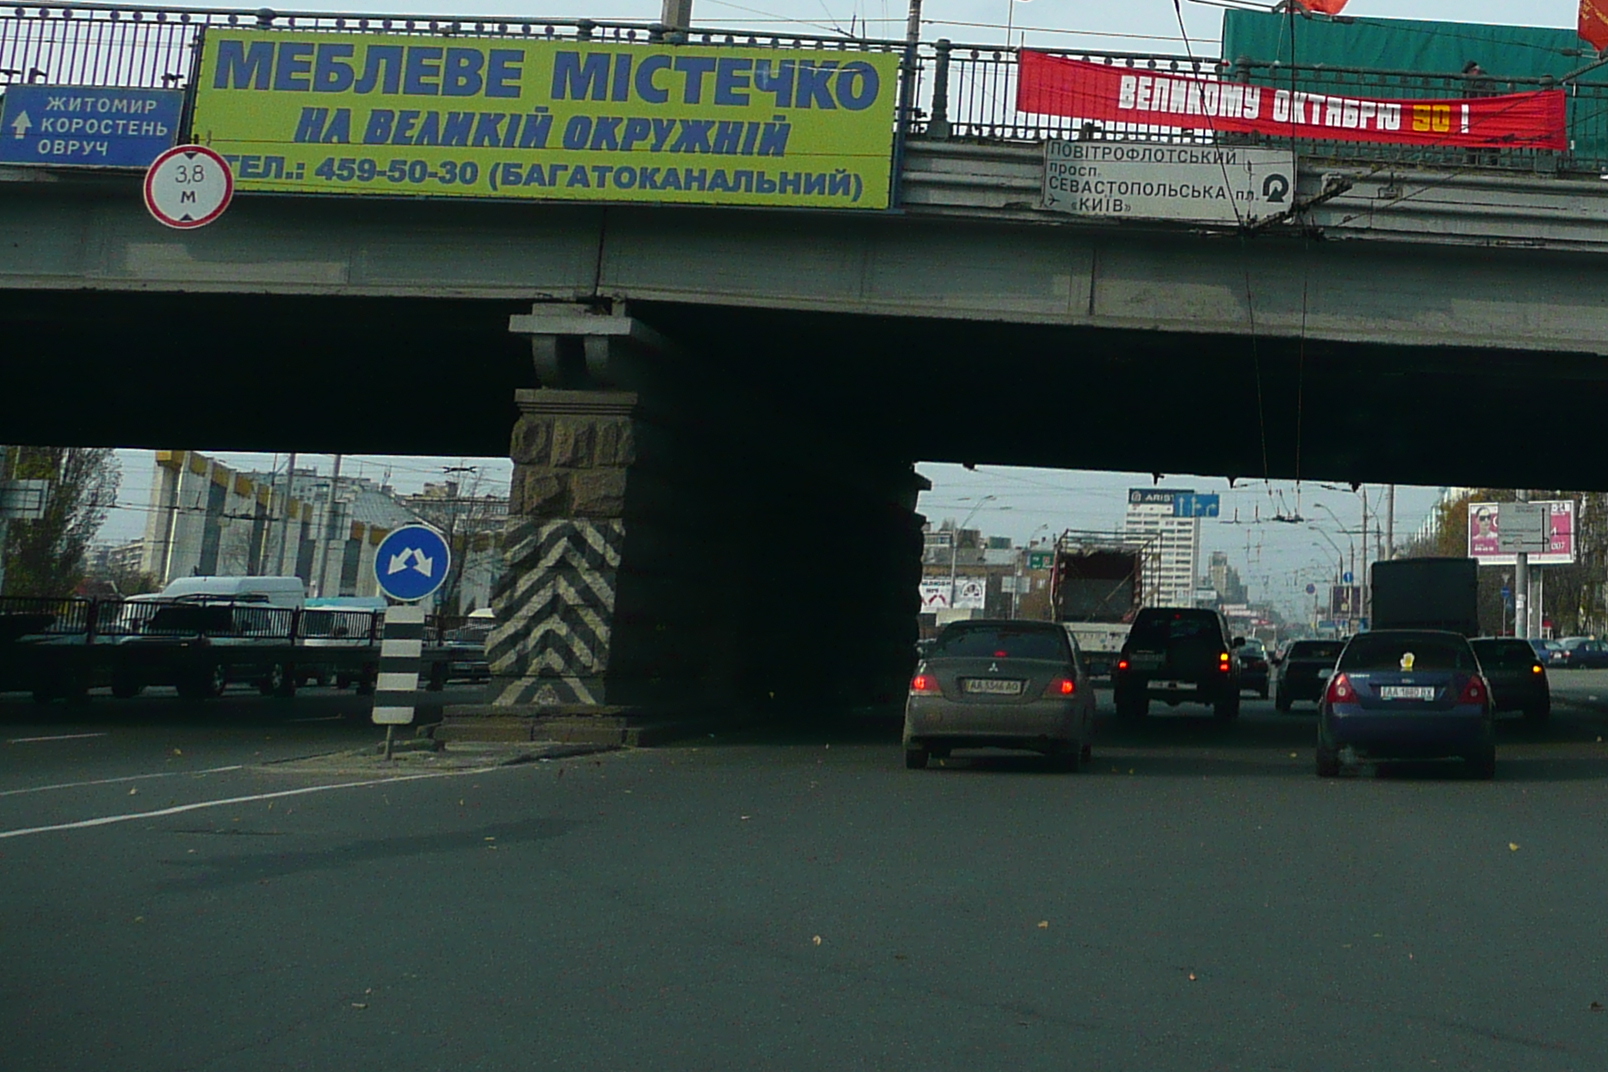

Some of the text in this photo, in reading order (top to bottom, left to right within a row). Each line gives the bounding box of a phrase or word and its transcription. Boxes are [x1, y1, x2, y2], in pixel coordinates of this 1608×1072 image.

[213, 39, 880, 111] МЕБЛЕВЕ МІСТЕЧКО
[45, 96, 158, 115] ЖИТОМИР
[1118, 74, 1260, 120] ВЕЛИКОМУ
[1272, 89, 1401, 130] ОКТЯБРЮ
[1412, 104, 1450, 131] 90
[41, 117, 168, 136] КОРОСТЕНЬ
[293, 105, 792, 157] НА ВЕЛИКІЙ ОКРУЖНІЙ
[38, 139, 108, 156] ОВРУЧ
[1050, 141, 1237, 165] ПОВІТРОФЛОТСЬКИЙ
[174, 164, 205, 184] 3,8
[222, 154, 864, 203] ТЕЛ.: 459-50-30 (БАГАТОКАНАЛЬНИЙ)
[1050, 162, 1100, 178] просп.
[1049, 177, 1227, 200] СЕВАСТОПОЛЬСЬКА
[1145, 493, 1175, 502] ARIS
